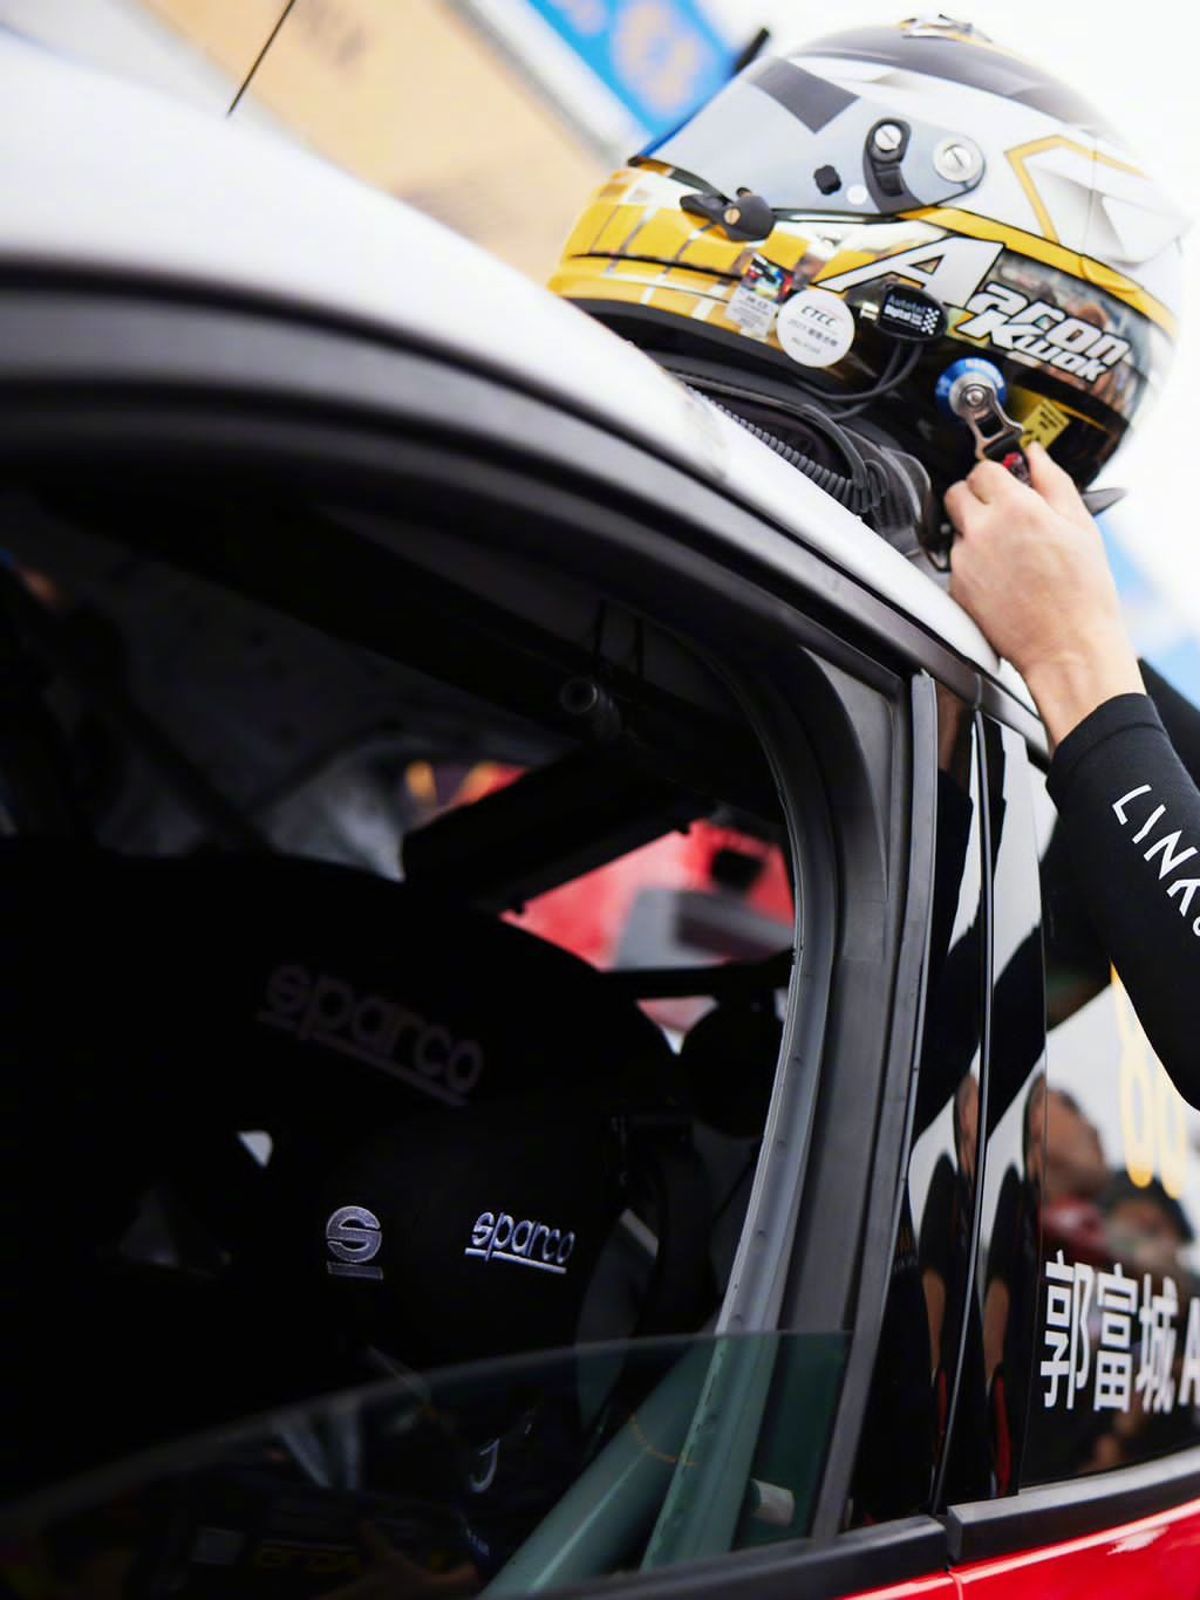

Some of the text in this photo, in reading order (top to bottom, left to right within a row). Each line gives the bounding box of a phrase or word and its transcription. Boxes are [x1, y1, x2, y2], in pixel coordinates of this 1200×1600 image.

[955, 308, 1106, 382] Kwok
[267, 965, 484, 1098] sparco
[466, 1212, 576, 1265] sparco
[1040, 1250, 1179, 1412] 郭富城
